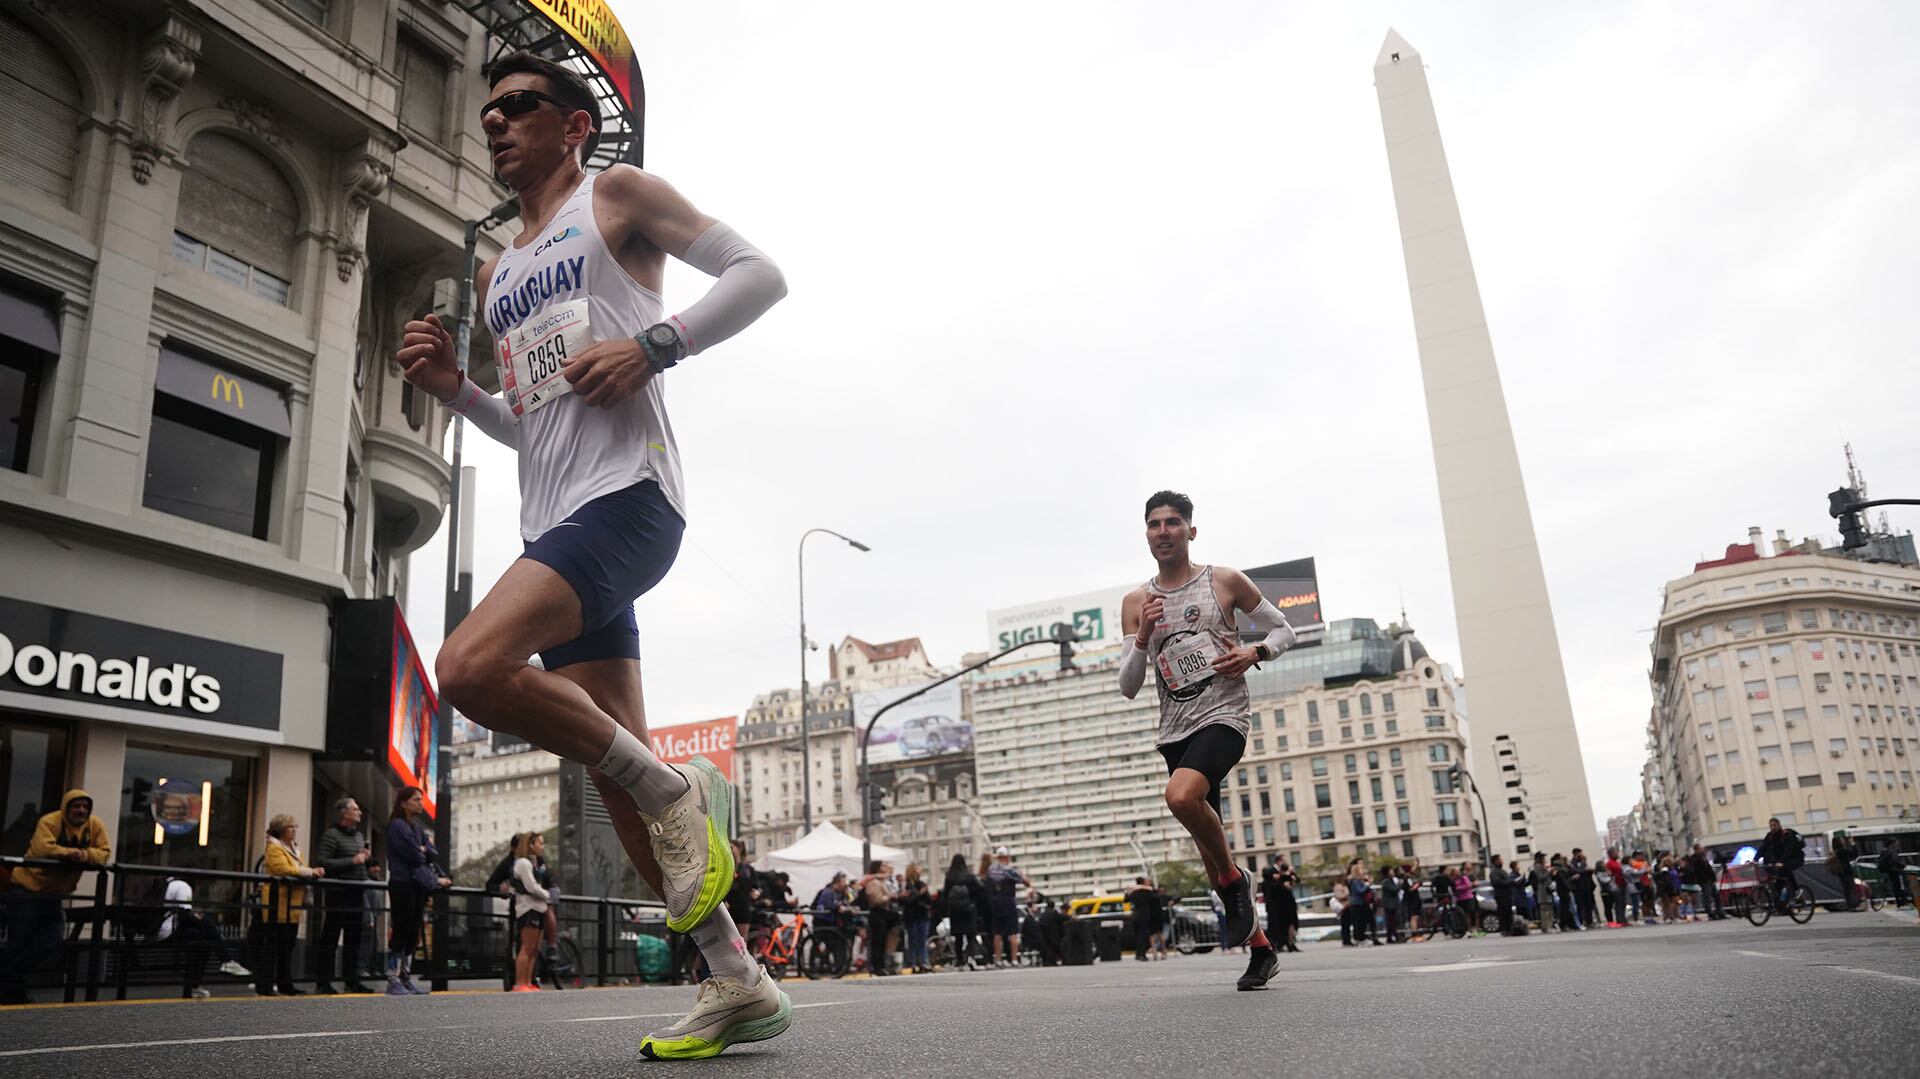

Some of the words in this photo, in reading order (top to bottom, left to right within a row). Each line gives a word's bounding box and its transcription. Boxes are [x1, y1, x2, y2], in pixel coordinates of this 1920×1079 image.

[535, 228, 570, 257] CAU
[489, 255, 585, 335] URUGUAY
[533, 310, 575, 337] telecom
[527, 333, 567, 384] C859
[997, 605, 1065, 625] UNIVERSIDAD
[1077, 614, 1100, 640] 21
[1177, 650, 1207, 675] C896
[653, 725, 730, 759] Medifé
